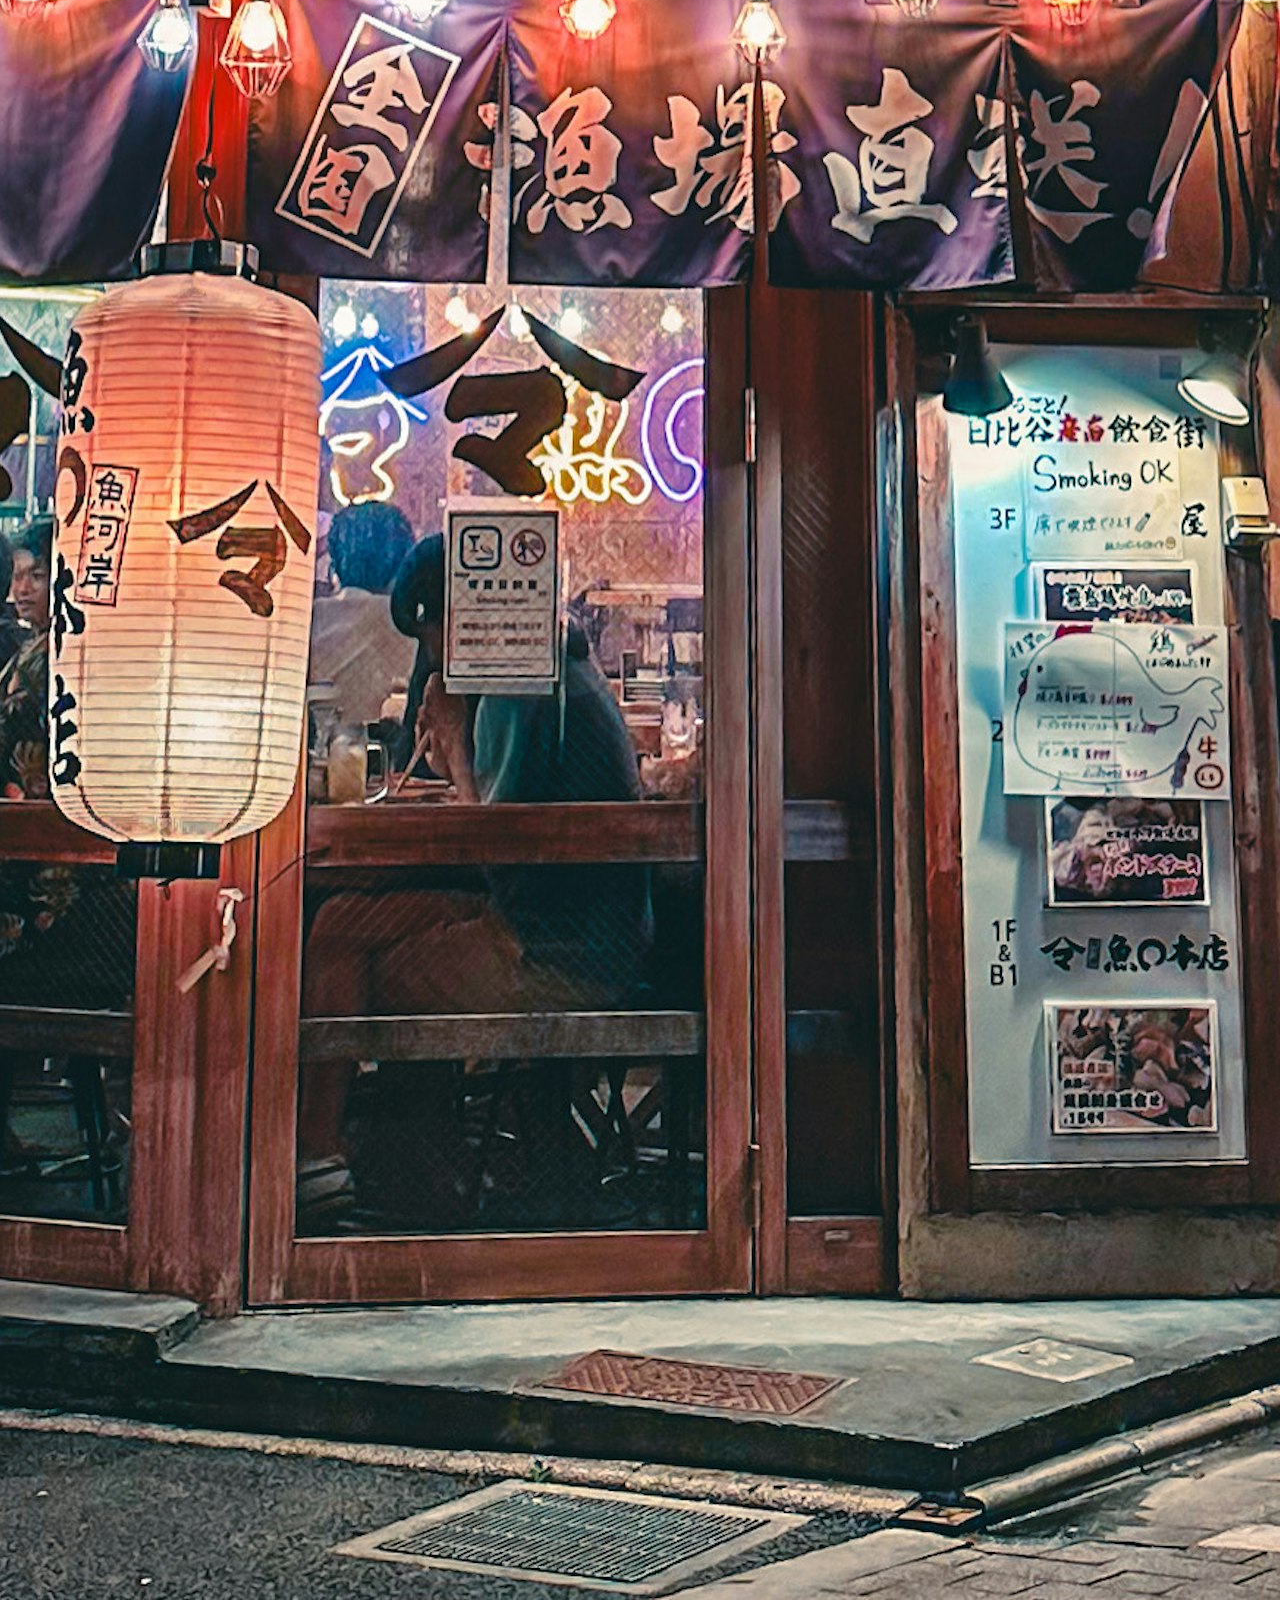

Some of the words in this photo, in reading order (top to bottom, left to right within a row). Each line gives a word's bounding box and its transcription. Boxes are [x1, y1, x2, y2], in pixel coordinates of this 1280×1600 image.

[303, 42, 432, 238] 全国
[1033, 453, 1132, 492] Smoking
[1140, 458, 1174, 485] OK
[989, 507, 1017, 531] 3F
[1180, 502, 1208, 538] 屋
[82, 470, 126, 600] 魚河岸
[991, 920, 1017, 942] 1F
[998, 945, 1012, 962] &
[990, 964, 1018, 986] B1
